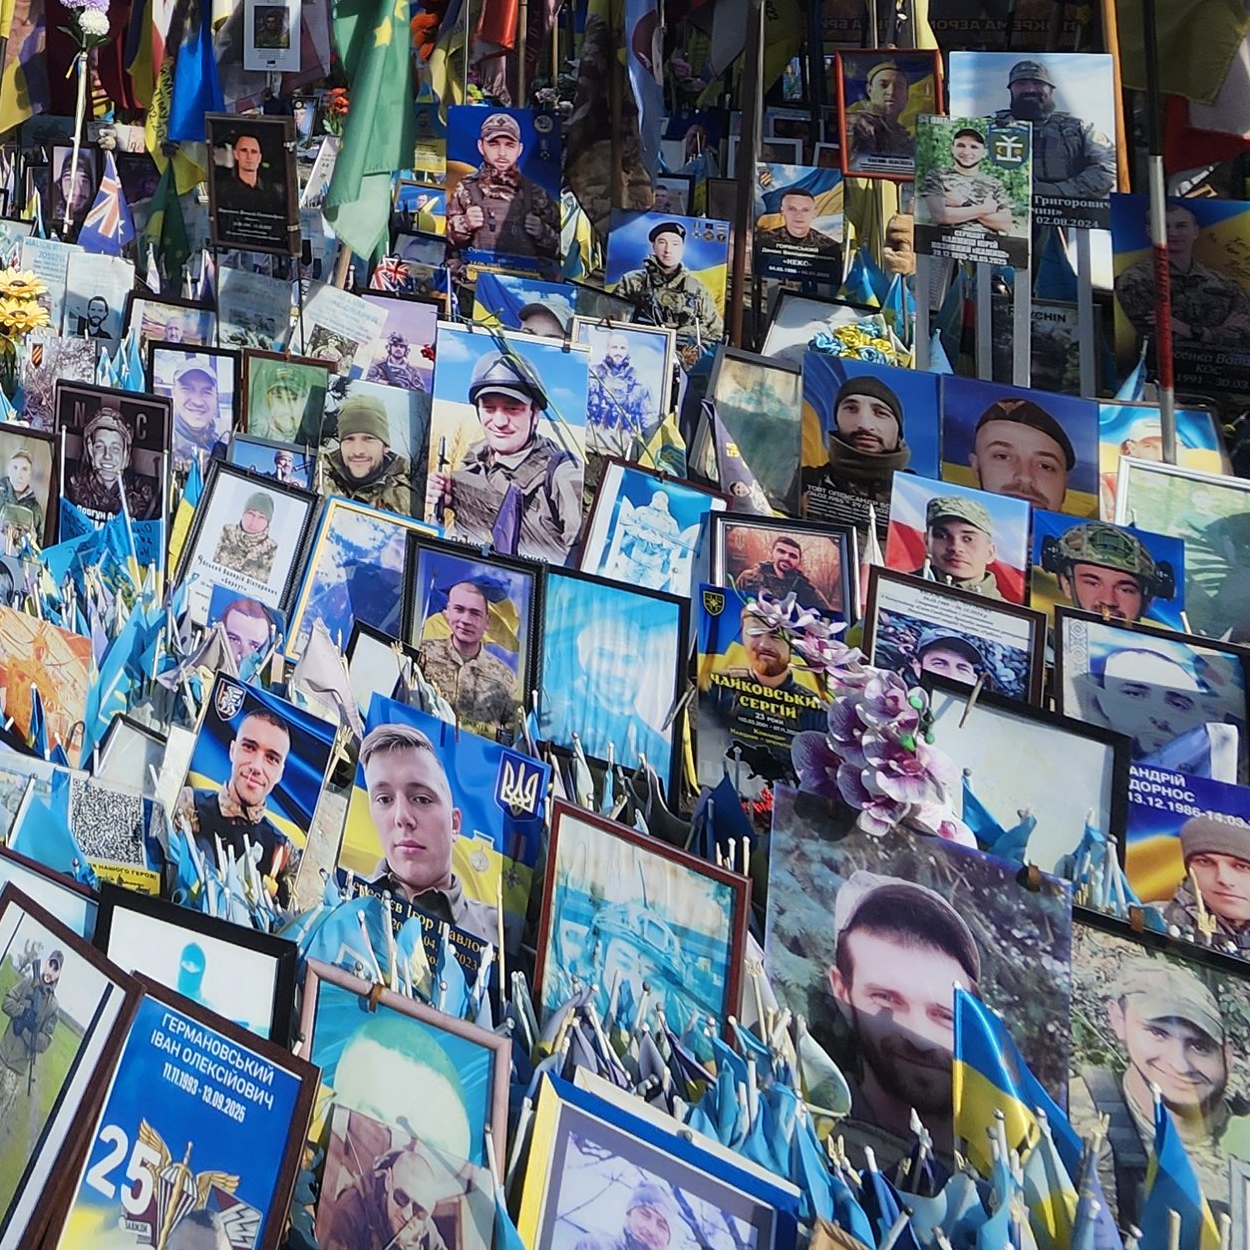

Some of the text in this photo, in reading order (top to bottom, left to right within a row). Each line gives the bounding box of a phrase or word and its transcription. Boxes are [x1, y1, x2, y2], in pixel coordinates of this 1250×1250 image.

[738, 694, 798, 720] СЕРГІЙ
[754, 712, 765, 722] 23
[1128, 764, 1186, 788] АНДРІЙ
[1128, 778, 1196, 803] ДОРНОС
[99, 863, 130, 875] НАШОГО
[161, 1012, 275, 1087] ГЕРМАНОВСЬКИЙ
[150, 1029, 275, 1112] ІВАН ОЛЕКСІЙОВИЧ
[161, 1061, 199, 1096] 11.11.1993
[201, 1083, 247, 1124] 13.09.2025
[85, 1124, 162, 1216] 25
